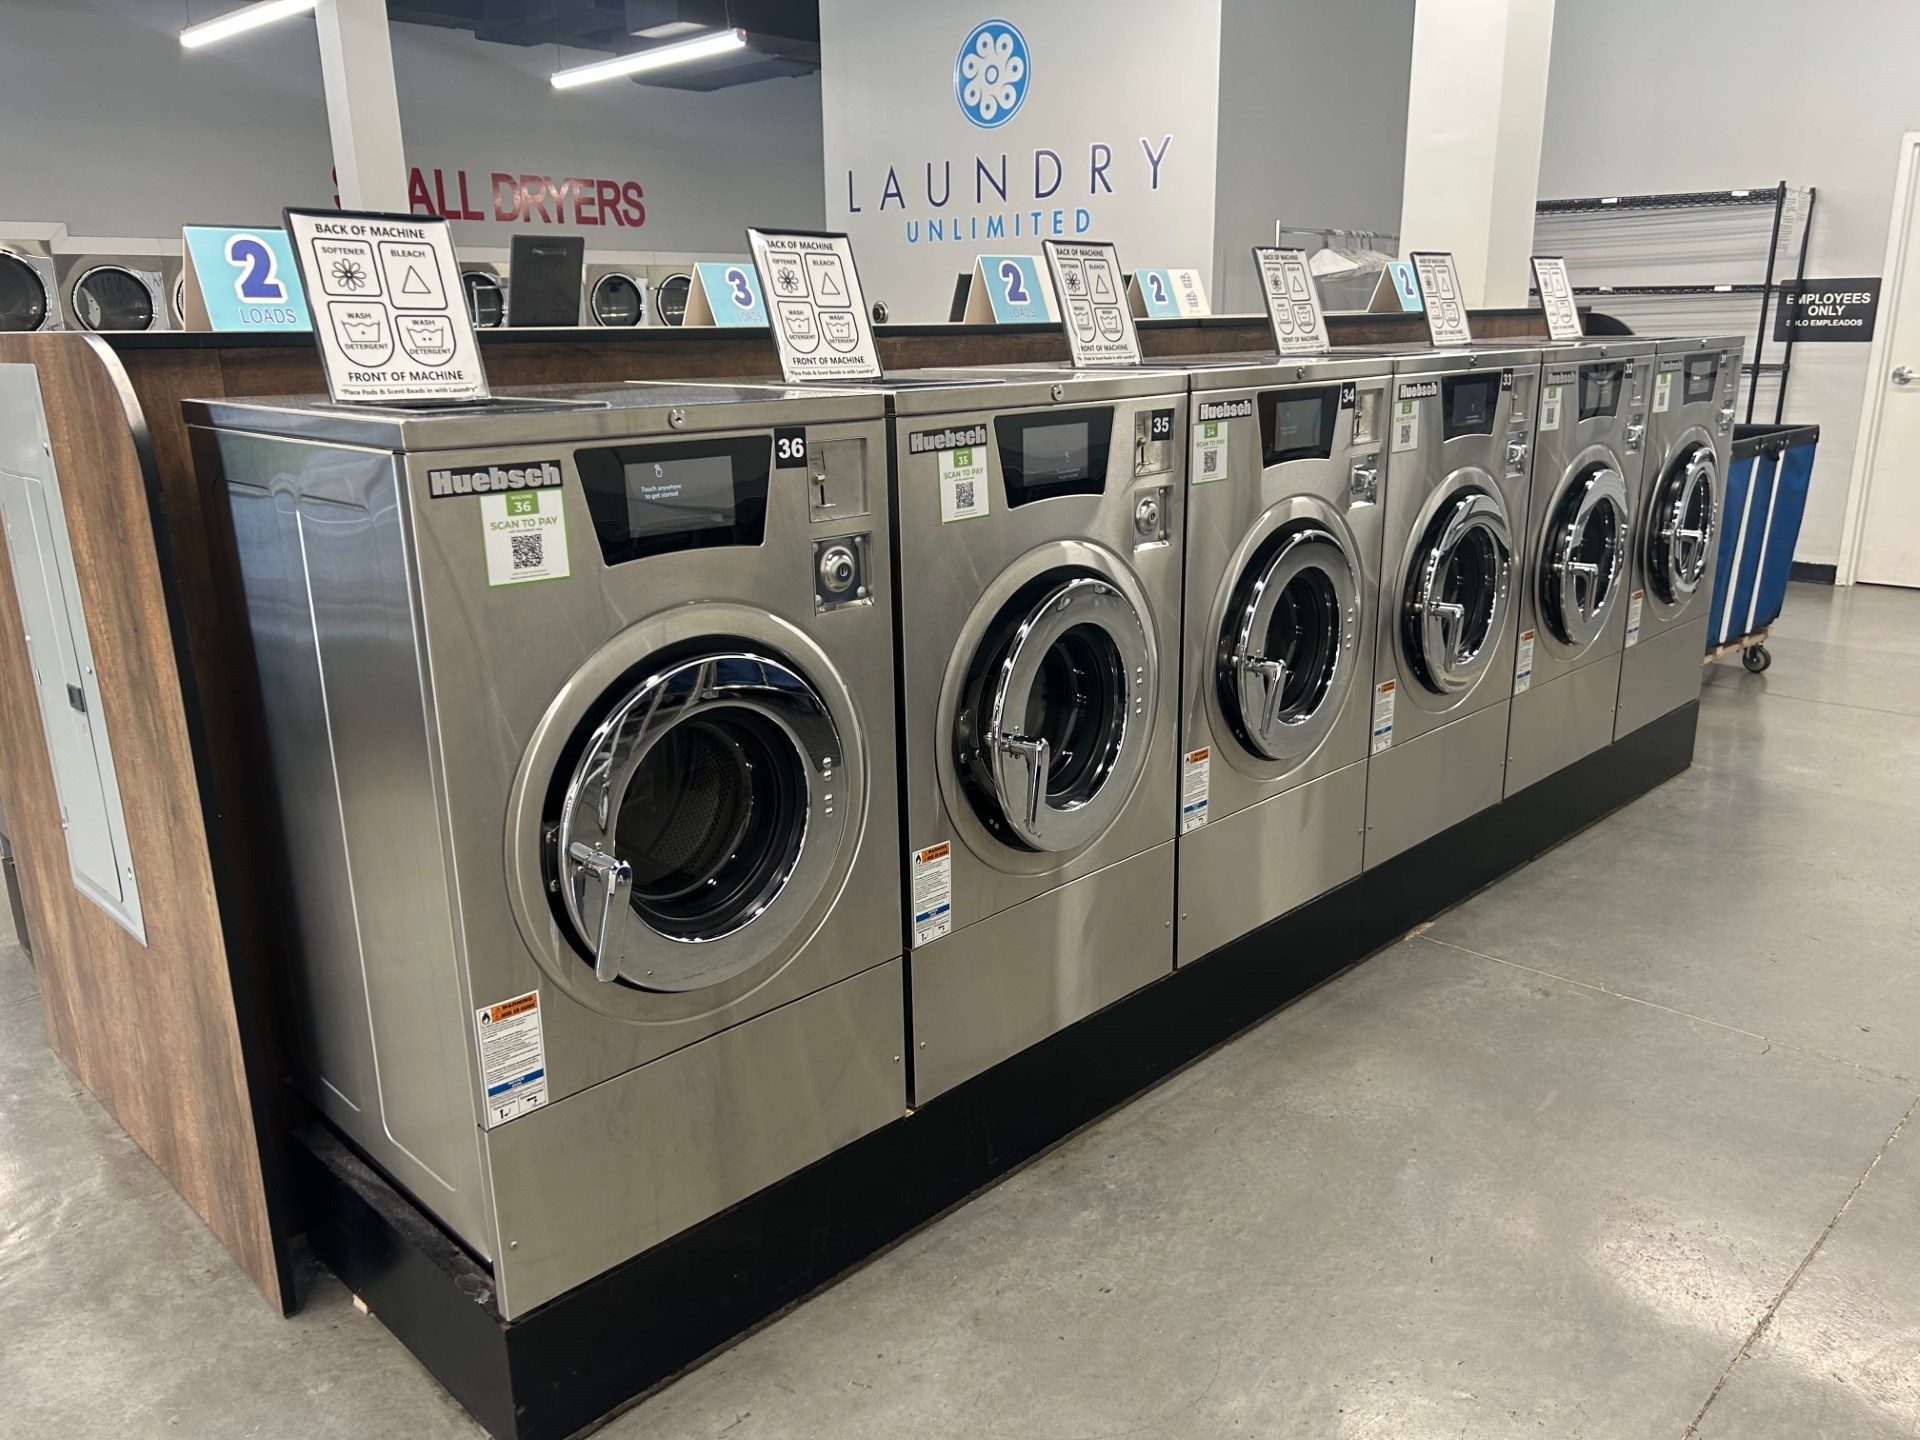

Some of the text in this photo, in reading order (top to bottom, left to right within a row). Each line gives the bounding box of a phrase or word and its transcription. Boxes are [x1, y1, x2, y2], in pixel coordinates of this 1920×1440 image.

[848, 135, 1172, 213] LAUNDRY
[491, 172, 645, 228] DRYERS
[315, 223, 426, 240] BACK OF MACHINE
[906, 208, 1091, 243] UNLIMITED
[322, 246, 366, 256] SOFTENER
[390, 249, 426, 259] BLEACH
[788, 241, 798, 249] OF
[800, 242, 834, 251] MACHINE
[227, 236, 286, 301] 2
[726, 268, 754, 308] 3
[1001, 262, 1029, 303] 2
[1149, 273, 1167, 302] 2
[1400, 267, 1414, 296] 2
[239, 308, 298, 324] LOADS
[346, 312, 371, 320] WASH
[737, 311, 763, 322] LOADS
[1008, 307, 1036, 319] LOADS
[1807, 305, 1846, 316] ONLY
[1810, 319, 1863, 327] EMPLEADOS
[792, 356, 865, 365] FRONT OF MACHINE
[348, 370, 465, 382] FRONT OF MACHINE
[1502, 373, 1512, 386] 33
[362, 388, 378, 396] Pods
[1342, 387, 1355, 404] 34
[1400, 382, 1437, 399] Huebsch
[1200, 399, 1251, 420] Huebsch
[1153, 416, 1170, 434] 35
[910, 425, 987, 452] Huebsch
[778, 437, 805, 460] 36
[958, 455, 969, 466] 35
[430, 463, 561, 496] Huebsch
[944, 470, 961, 480] SCAN
[962, 469, 971, 477] TO
[972, 467, 984, 475] PAY
[514, 501, 532, 513] 36
[490, 519, 520, 531] SCAN
[522, 518, 536, 528] TO
[538, 516, 558, 526] PAY
